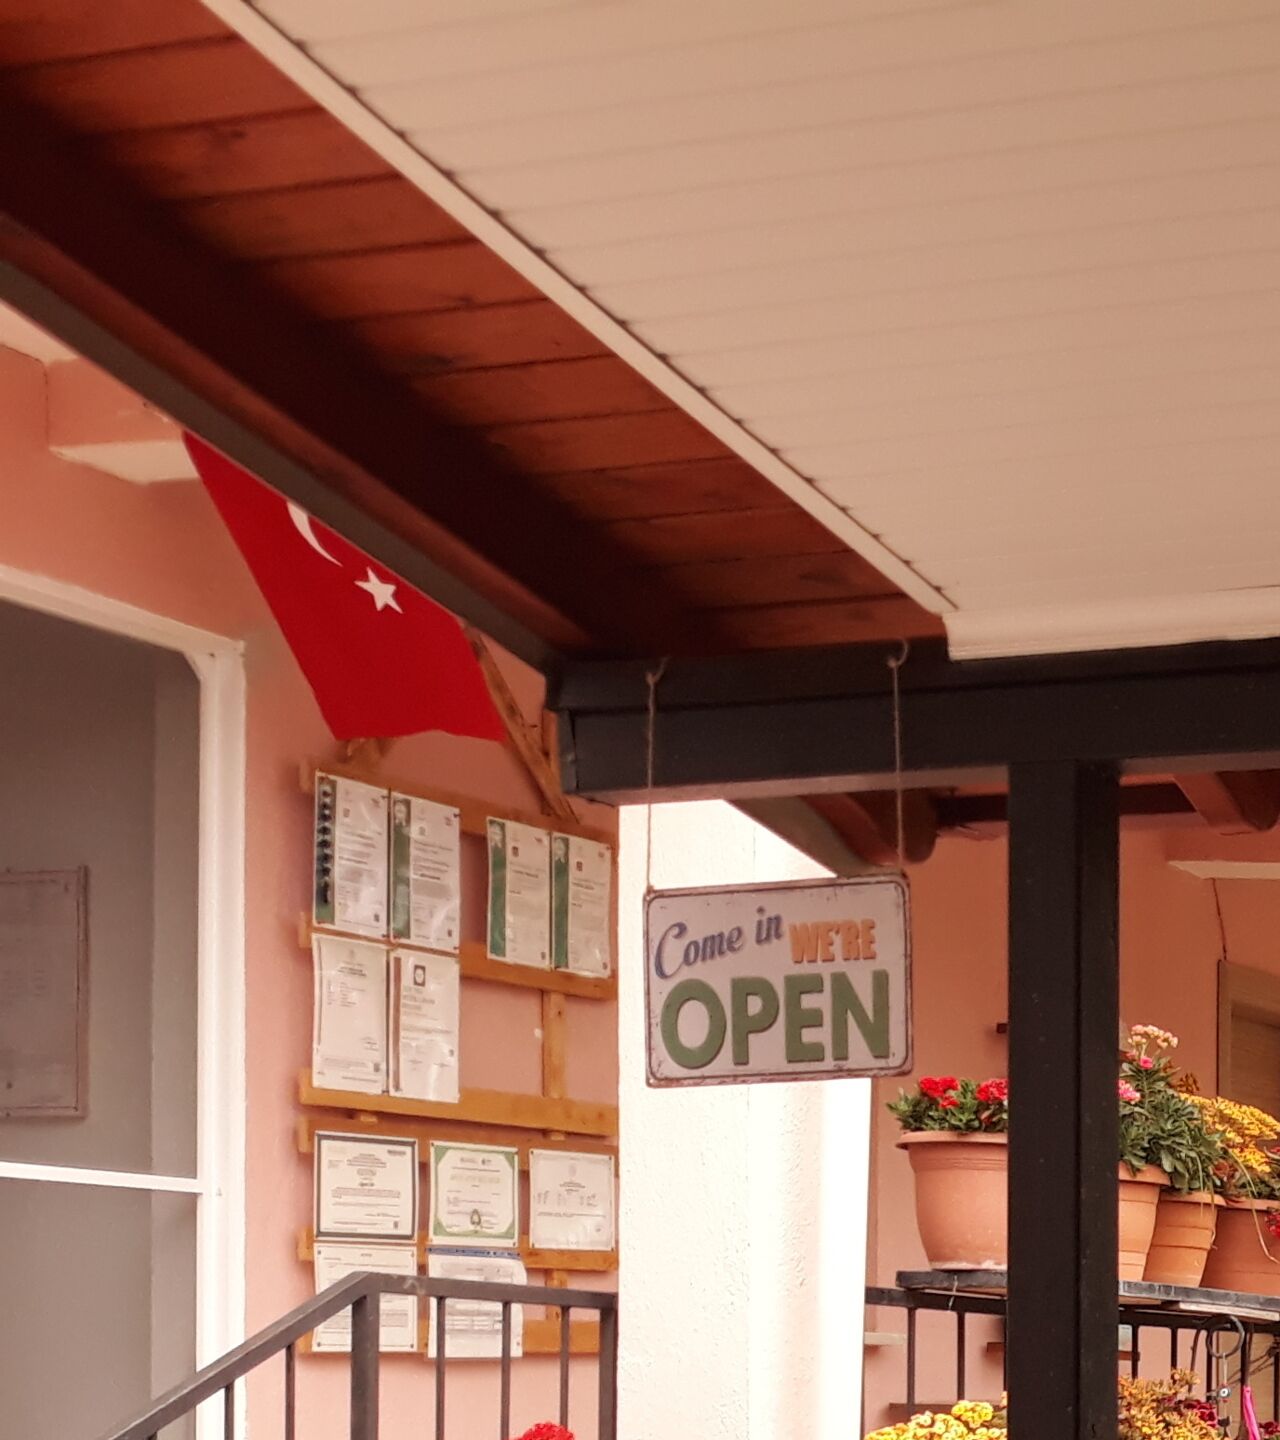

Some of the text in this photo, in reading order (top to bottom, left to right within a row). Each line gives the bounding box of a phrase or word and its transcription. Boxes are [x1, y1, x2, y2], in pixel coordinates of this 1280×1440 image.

[654, 905, 877, 980] Come in WE'RE
[660, 968, 891, 1070] OPEN
